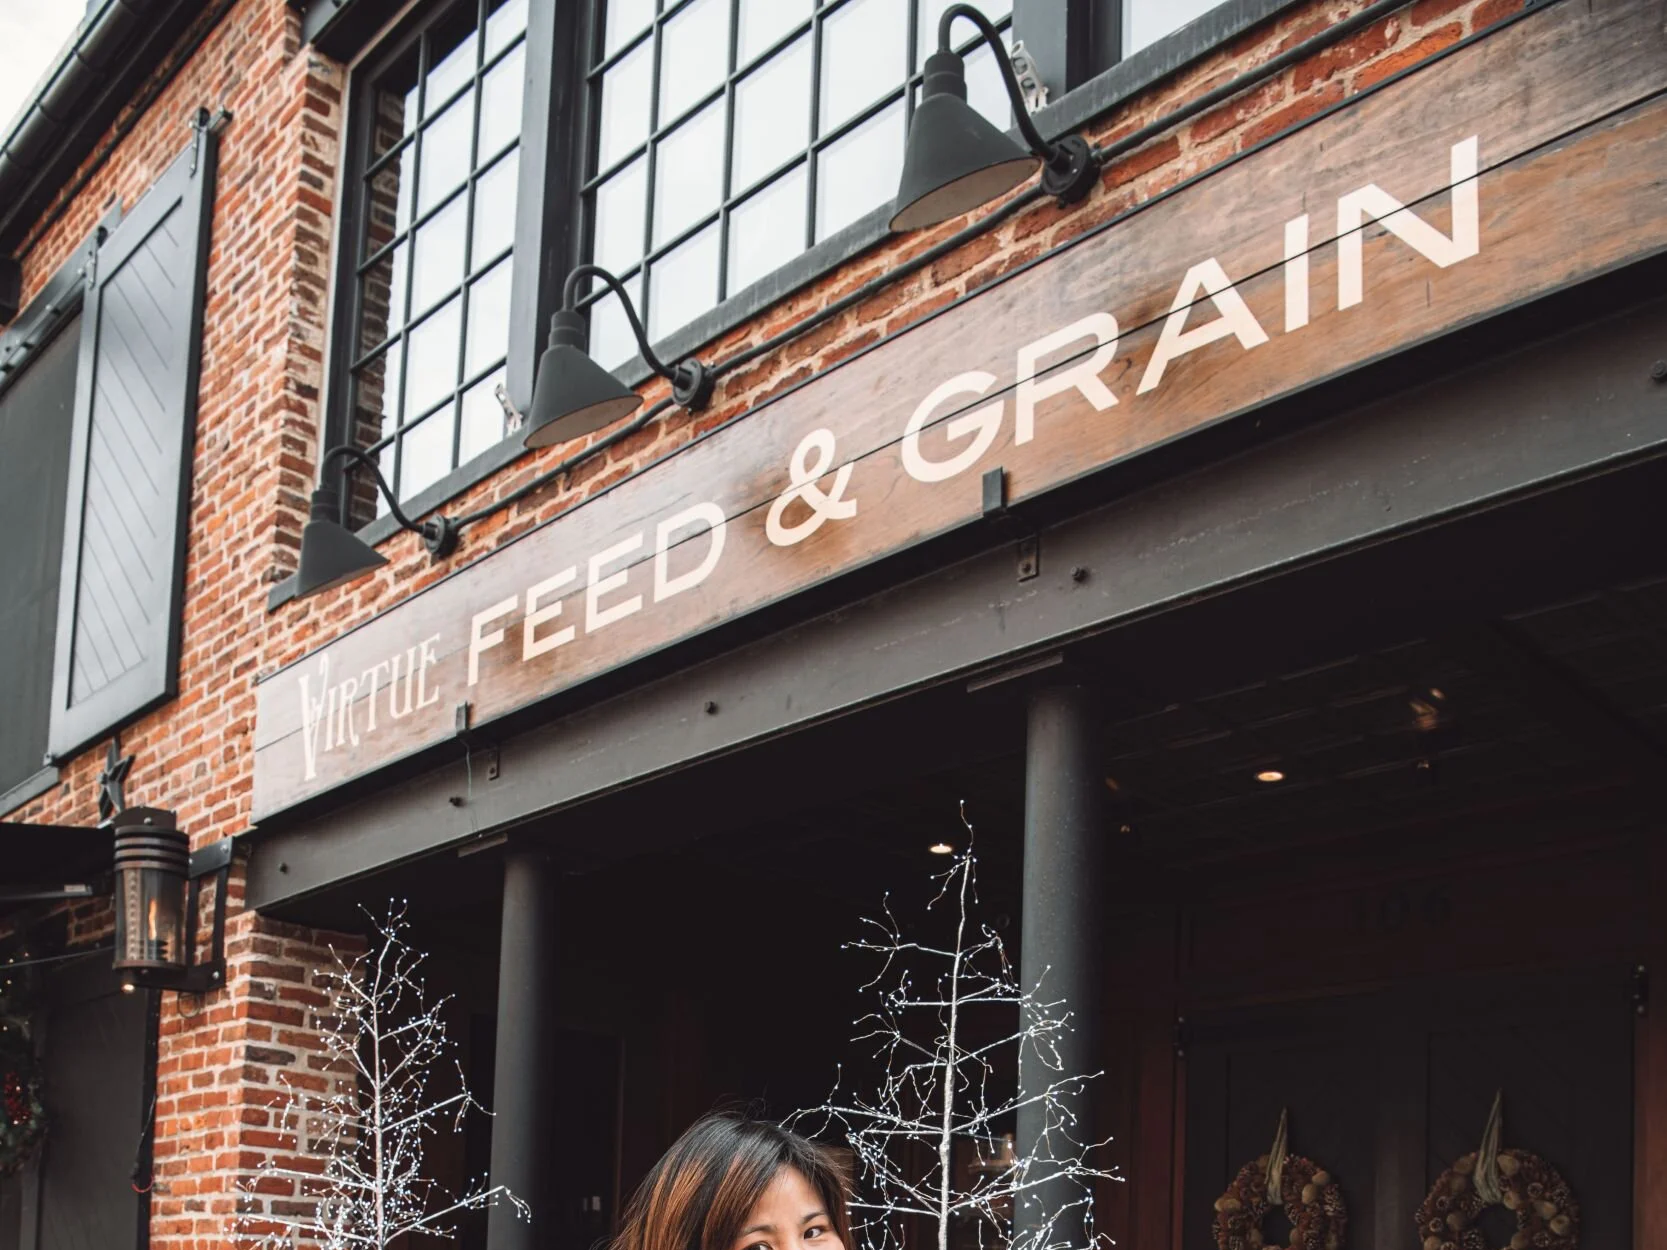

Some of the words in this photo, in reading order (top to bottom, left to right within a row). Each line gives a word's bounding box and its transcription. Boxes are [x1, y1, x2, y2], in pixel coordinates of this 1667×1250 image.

[297, 631, 441, 781] VIRTUE
[467, 501, 727, 687] FEED
[765, 427, 858, 547] &
[900, 134, 1480, 483] GRAIN
